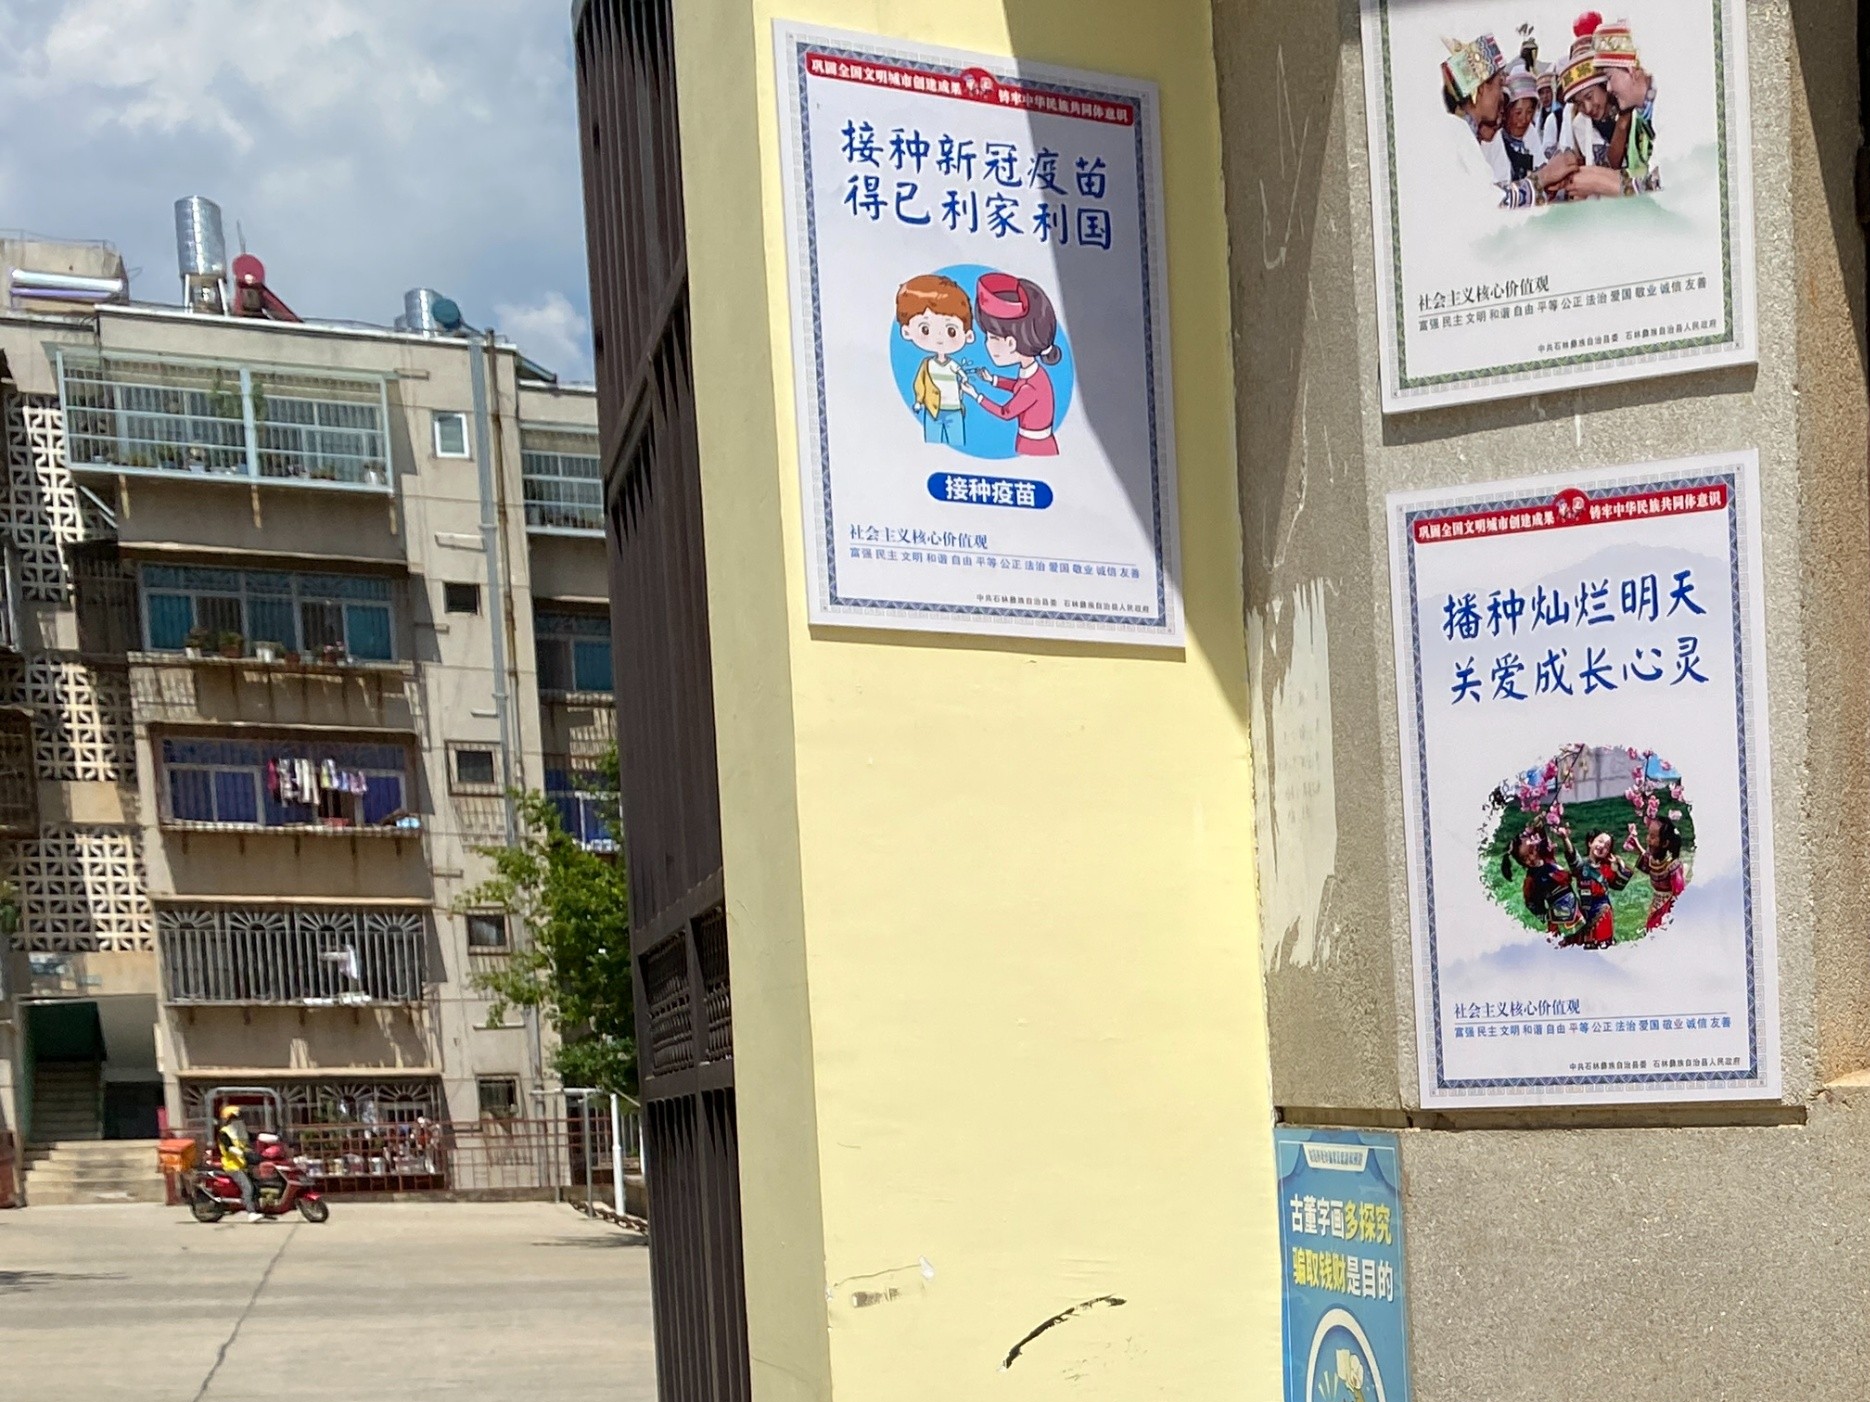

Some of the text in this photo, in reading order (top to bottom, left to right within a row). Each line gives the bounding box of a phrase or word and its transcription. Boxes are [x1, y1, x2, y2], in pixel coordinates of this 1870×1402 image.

[841, 119, 1106, 199] 接种新冠疫苗
[1418, 275, 1549, 312] 社会主义核心价值观
[945, 475, 1036, 507] 接种疫苗
[1418, 491, 1722, 540] 巩固全国文明城市创建成果 铸牢中华民族共同体意识
[850, 524, 988, 549] 社会主义核心价值观
[1442, 569, 1707, 641] 播种灿烂明天
[1450, 636, 1710, 705] 关爱成长心灵
[1454, 998, 1580, 1019] 社会主义核心价值观
[1290, 1193, 1392, 1245] 古董字画多探究
[1292, 1247, 1393, 1302] 骗取钱财是目的
